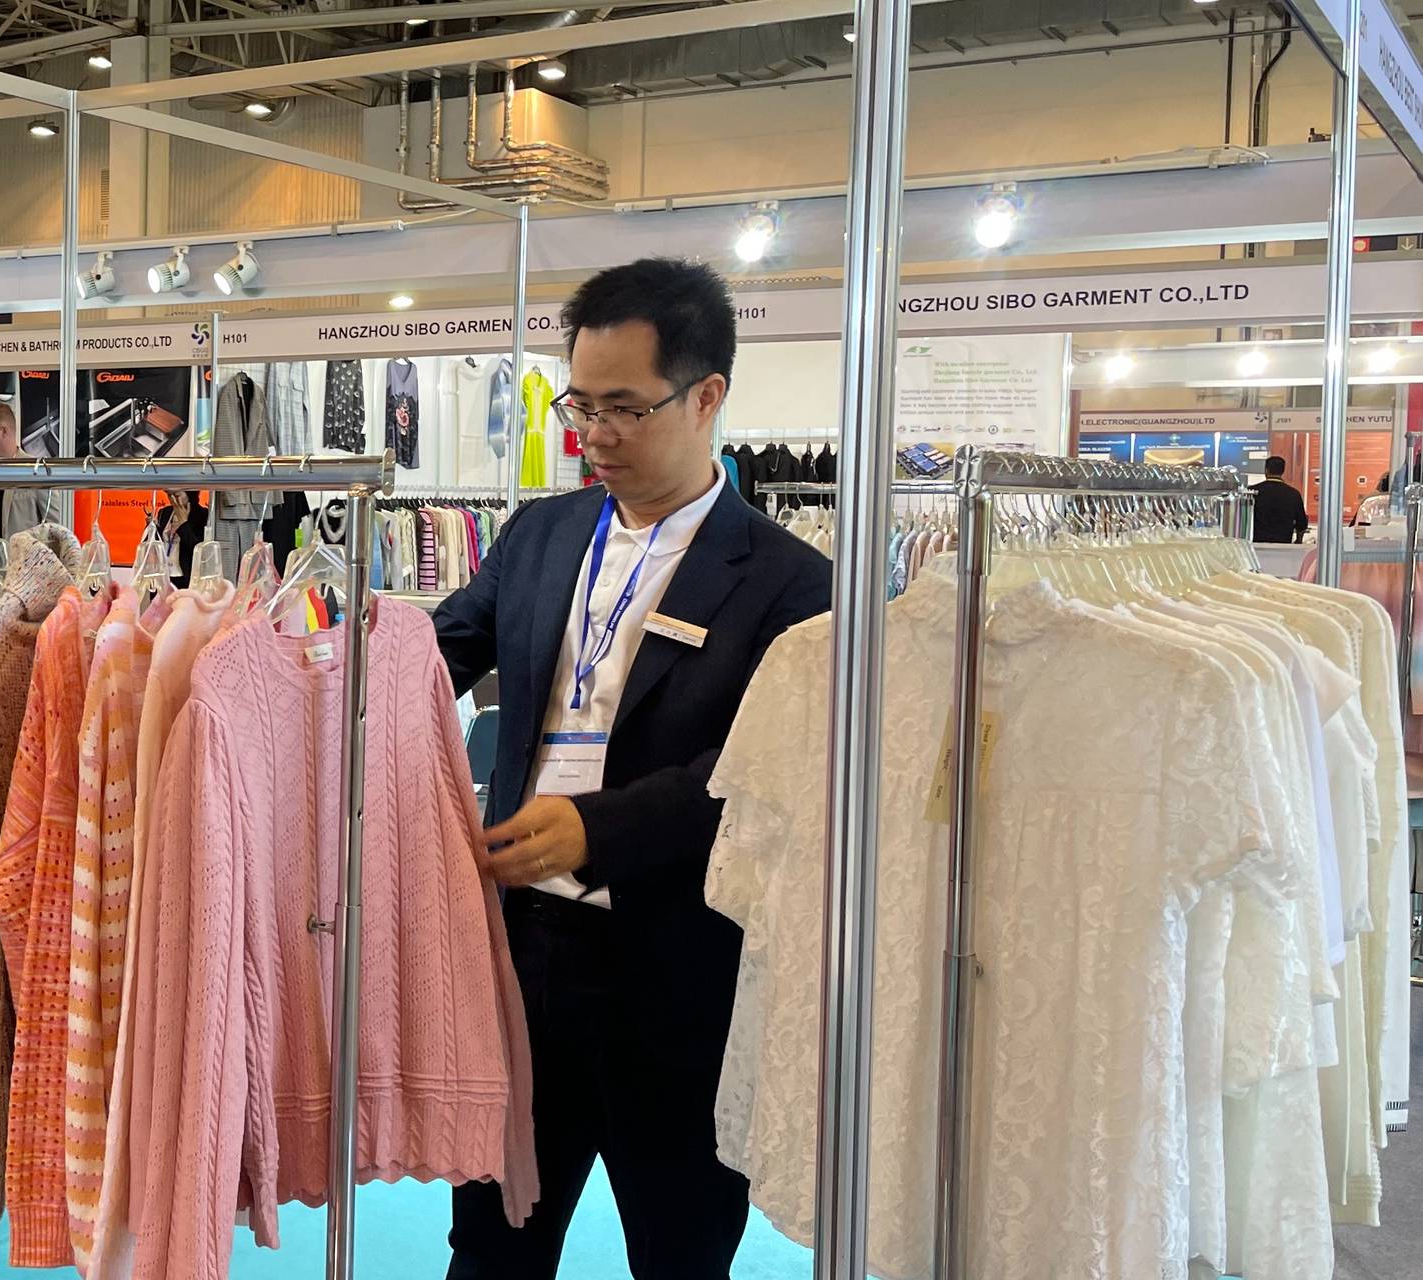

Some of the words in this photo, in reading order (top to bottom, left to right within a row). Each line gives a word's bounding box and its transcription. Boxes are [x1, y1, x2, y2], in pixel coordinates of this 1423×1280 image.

[898, 296, 979, 312] NGZHOU
[986, 293, 1036, 310] SIBO
[1043, 288, 1152, 307] GARMENT
[1159, 284, 1250, 304] CO.,LTD
[318, 324, 400, 340] HANGZHOU
[405, 322, 440, 336] SIBO
[445, 318, 513, 334] GARMEN
[21, 341, 27, 352] &
[82, 337, 133, 350] PRODUCTS
[223, 334, 247, 344] H101
[102, 499, 130, 507] tainless
